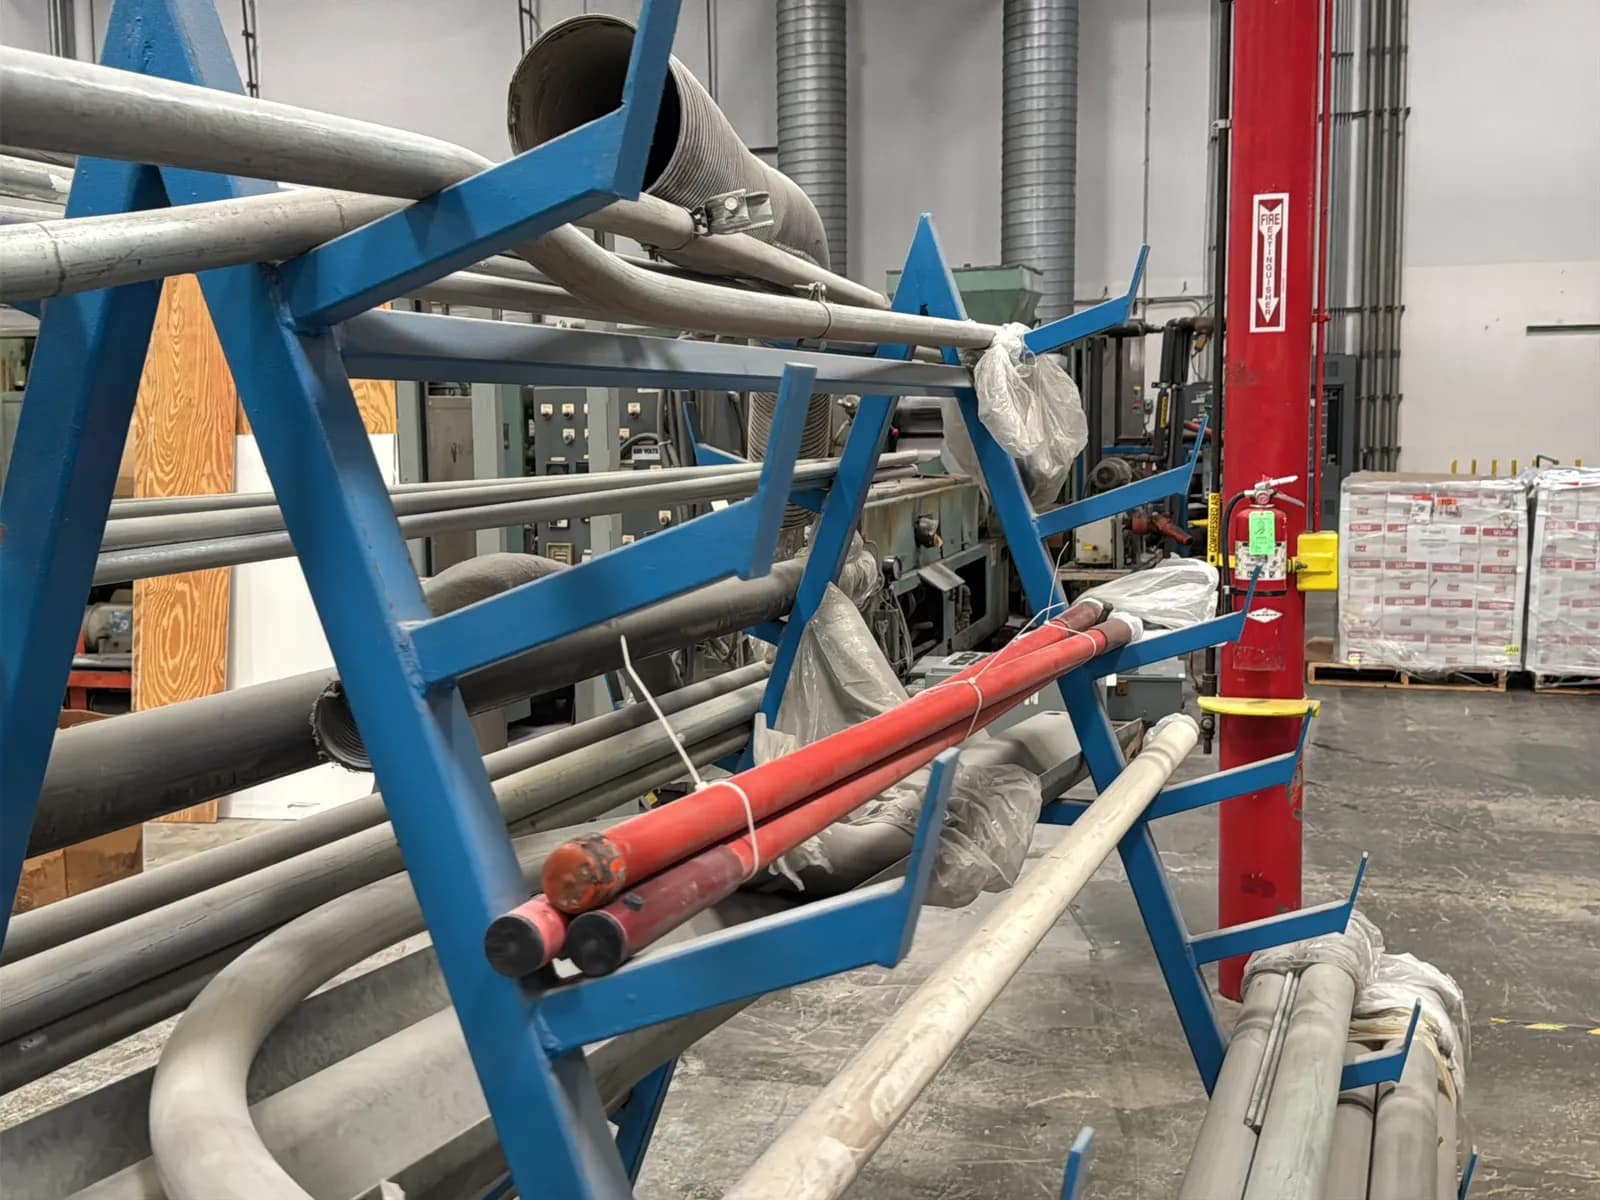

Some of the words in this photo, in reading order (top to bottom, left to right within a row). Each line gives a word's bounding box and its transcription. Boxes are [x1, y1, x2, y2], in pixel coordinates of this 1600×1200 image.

[1260, 213, 1280, 226] FIRE
[1264, 226, 1273, 315] EXTINGUISHER
[1210, 494, 1219, 506] AIR
[1208, 508, 1218, 553] COMPRESSED
